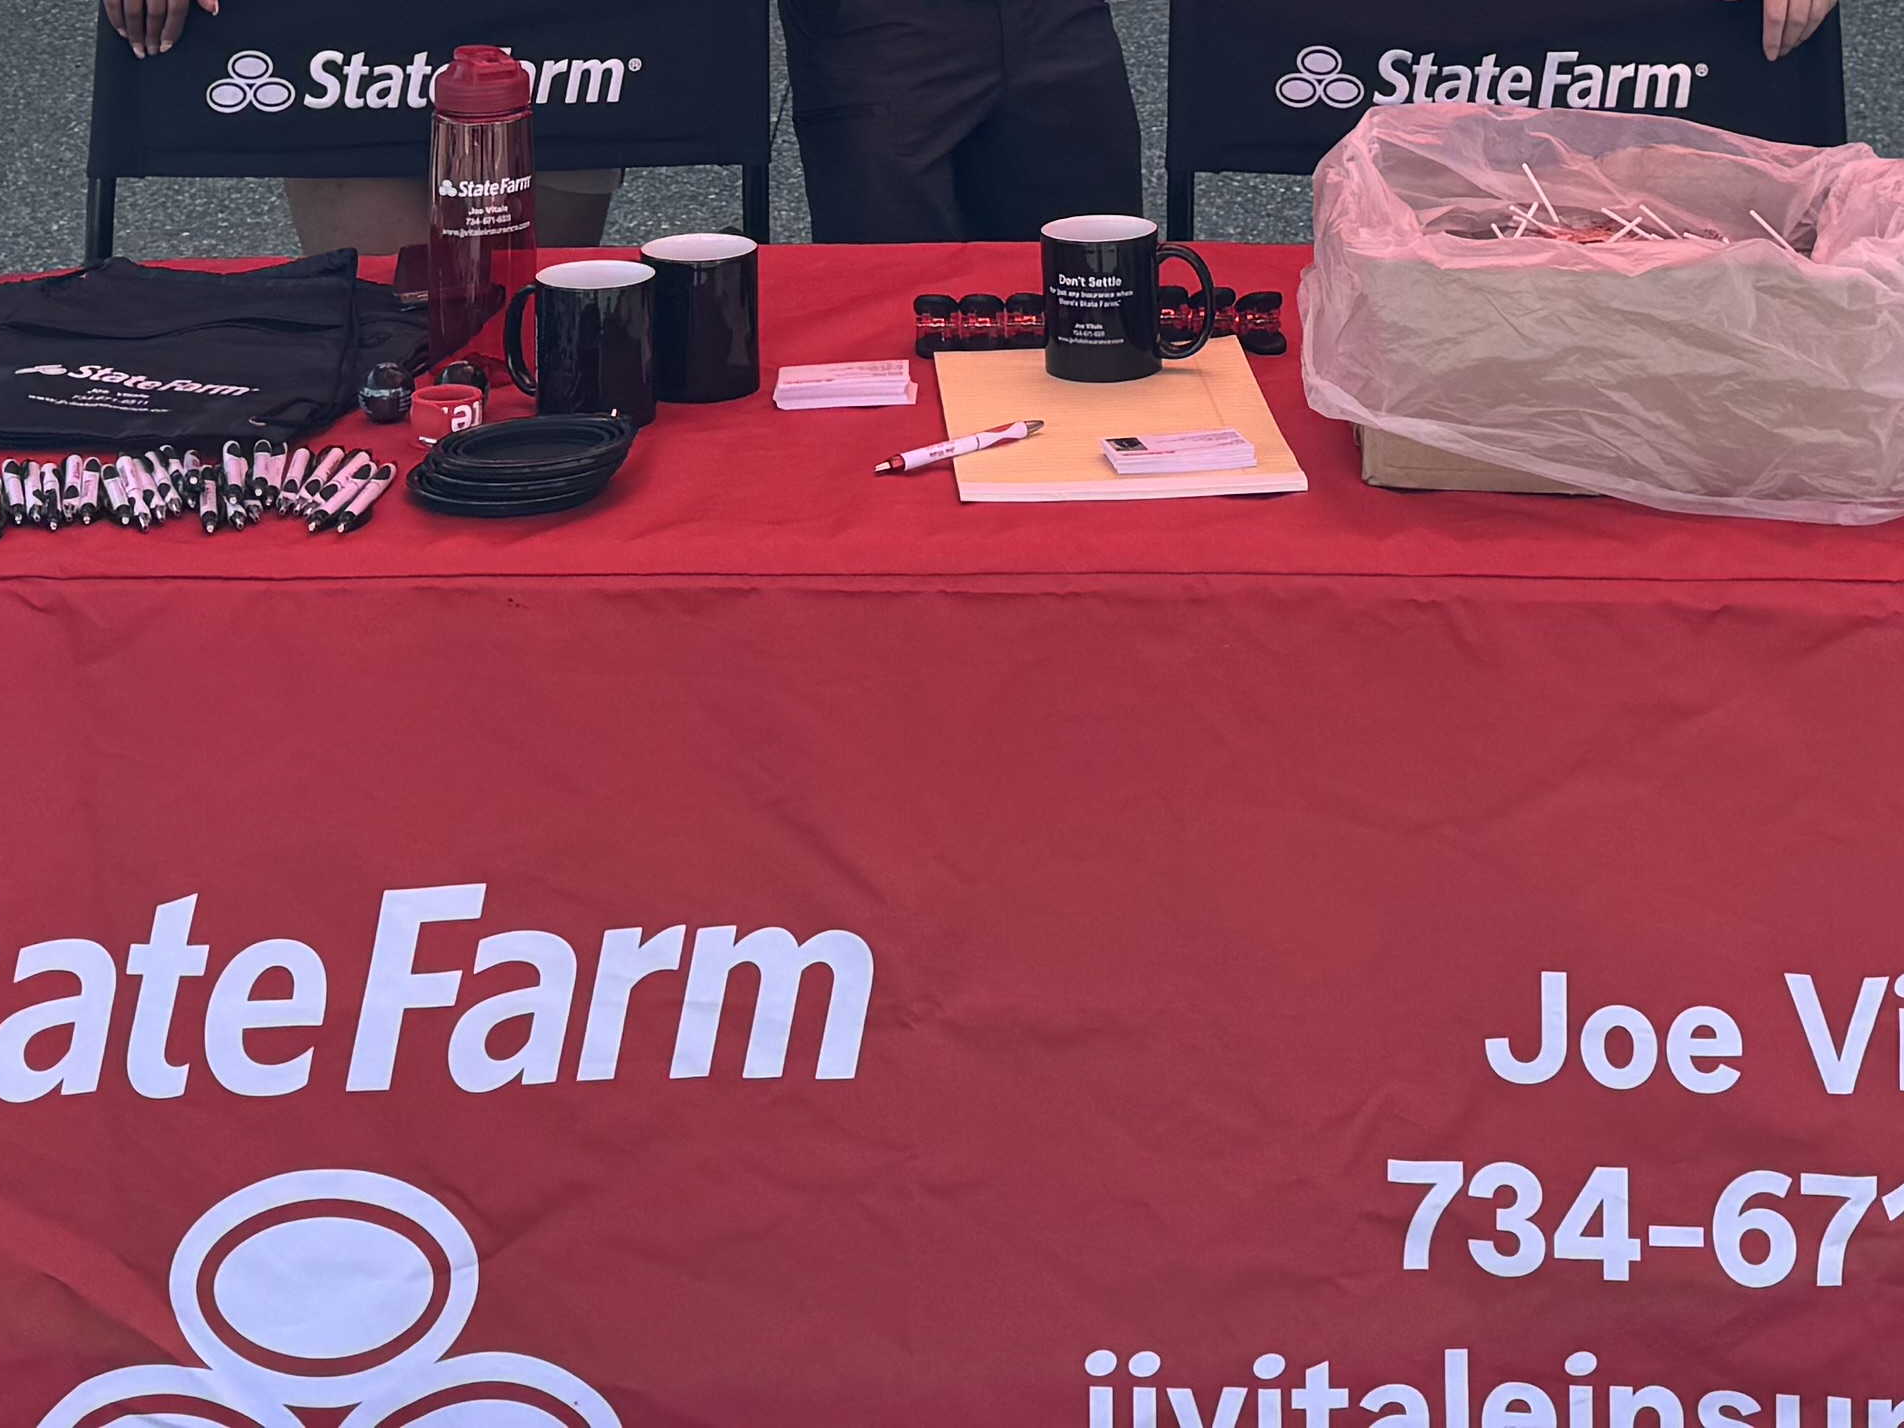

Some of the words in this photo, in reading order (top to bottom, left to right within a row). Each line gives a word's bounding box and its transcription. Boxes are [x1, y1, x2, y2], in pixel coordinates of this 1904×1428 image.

[1058, 274, 1085, 286] Don't
[1088, 276, 1122, 287] Settle
[1484, 970, 1744, 1094] Joe
